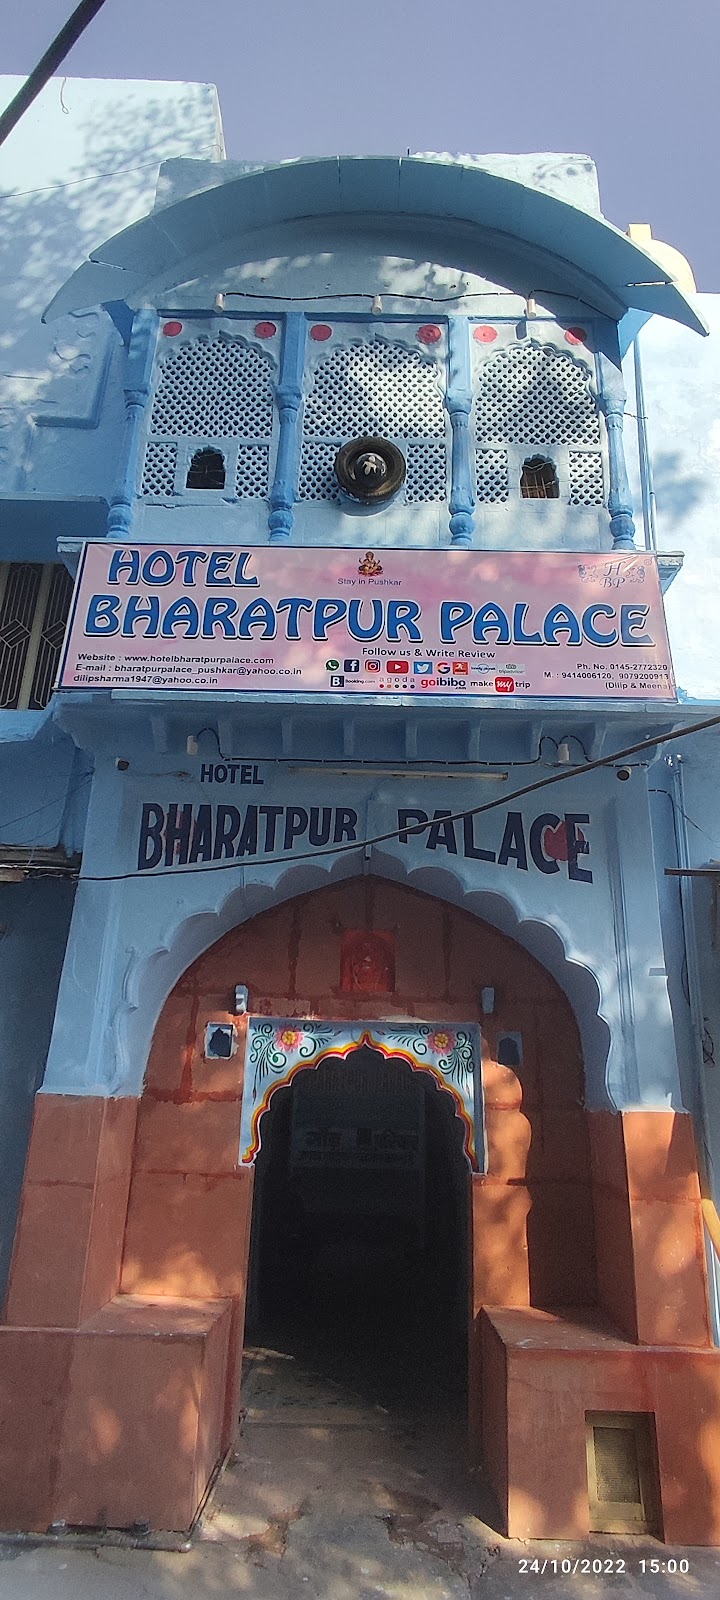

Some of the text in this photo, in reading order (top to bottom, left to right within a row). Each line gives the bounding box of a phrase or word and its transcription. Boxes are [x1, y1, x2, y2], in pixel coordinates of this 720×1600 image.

[107, 549, 259, 587] HOTEL
[337, 577, 356, 586] Stay
[599, 577, 626, 588] BP
[83, 594, 656, 647] BHARATPUR PALACE
[77, 653, 116, 661] Website
[124, 655, 274, 664] www.hotelbharatpurpalace.com
[362, 647, 496, 659] Follow us & Write Review
[75, 664, 106, 672] E-mail
[114, 665, 302, 675] bharatpurpalace_pushkar@yahoo.co.in
[609, 663, 668, 671] 0145-2772320
[73, 675, 218, 684] dilipsharma1947@yahoo.co.in
[421, 678, 466, 688] goibibo
[515, 681, 531, 689] trip
[605, 682, 628, 690] (Dilip
[200, 763, 264, 785] HOTEL
[137, 802, 594, 884] BHARATPUR PALACE
